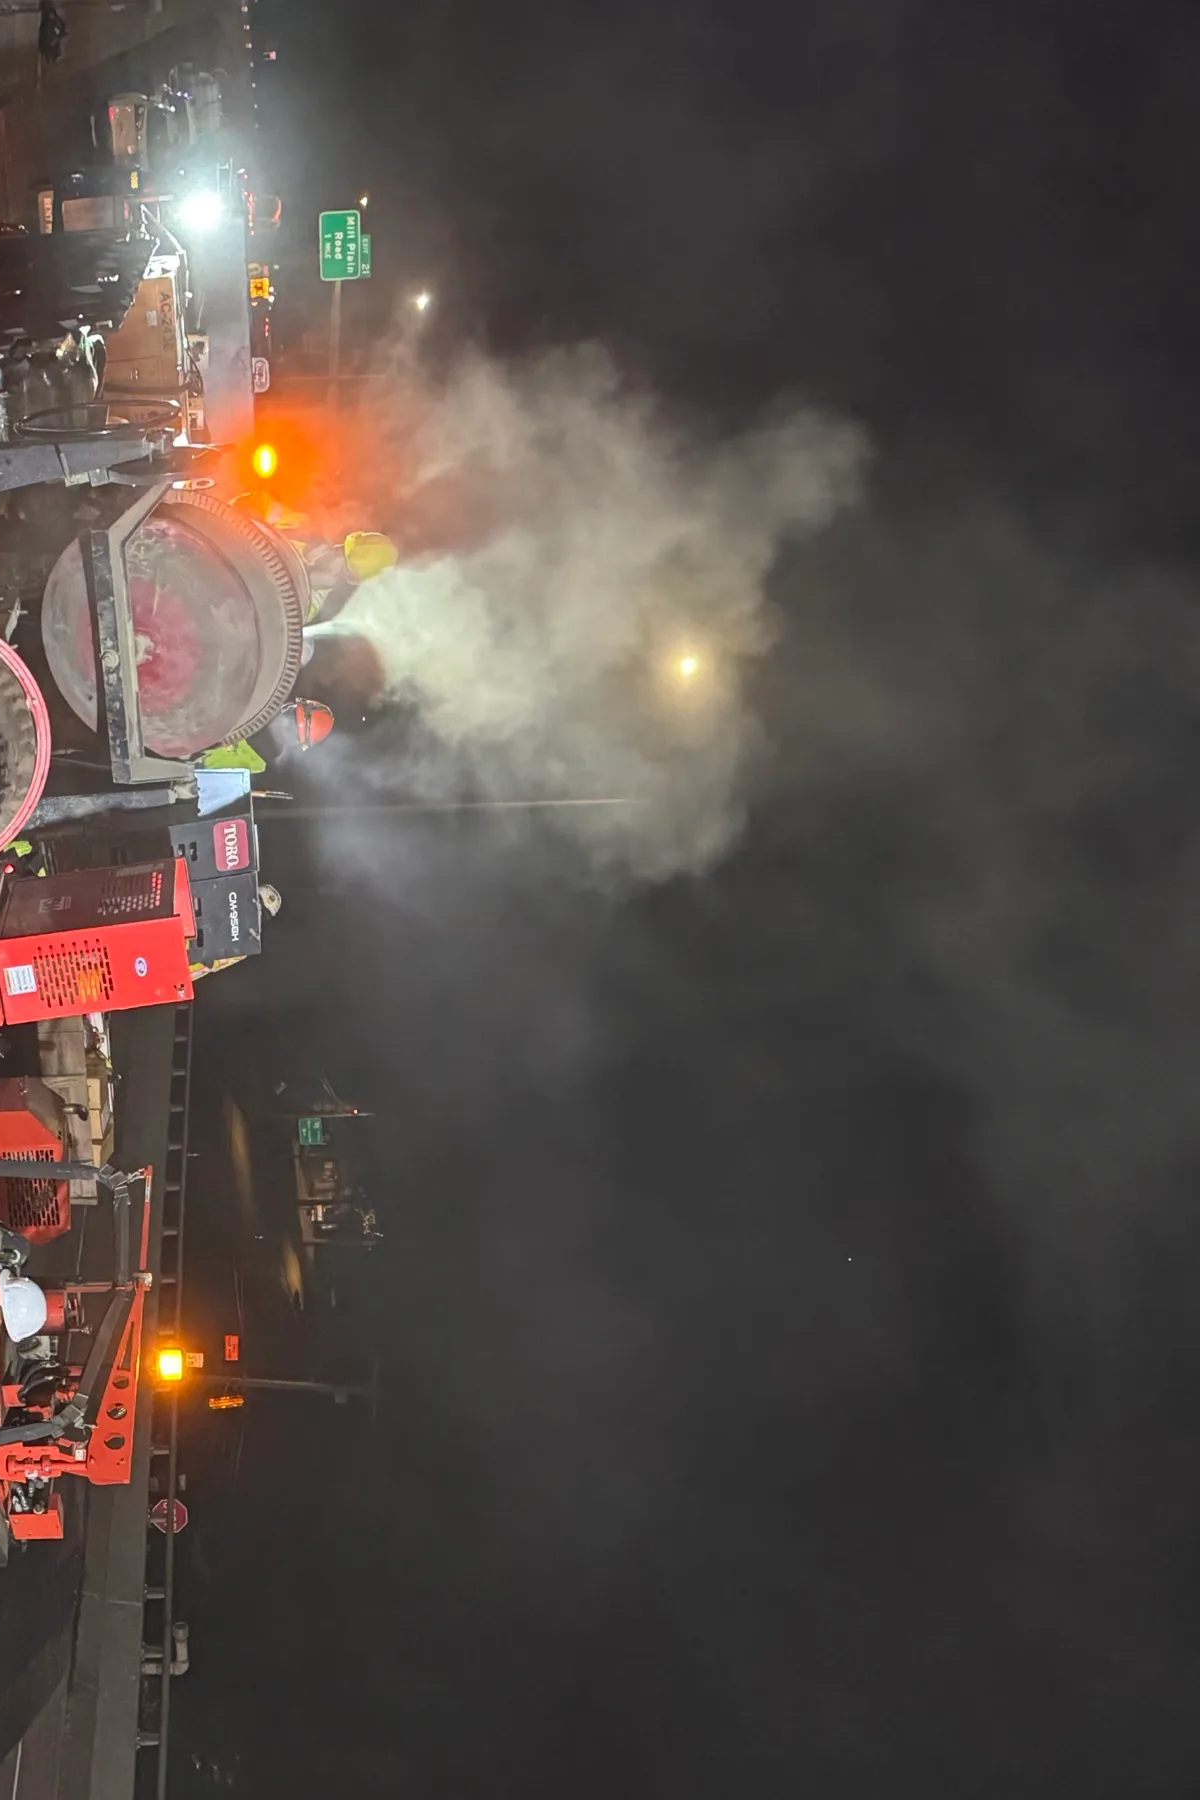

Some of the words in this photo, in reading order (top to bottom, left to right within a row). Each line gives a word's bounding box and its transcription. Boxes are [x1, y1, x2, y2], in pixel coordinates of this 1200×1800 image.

[346, 216, 355, 239] Mill
[334, 232, 343, 260] Road
[346, 243, 356, 273] Plain
[361, 263, 370, 274] 21
[224, 824, 239, 866] TORO
